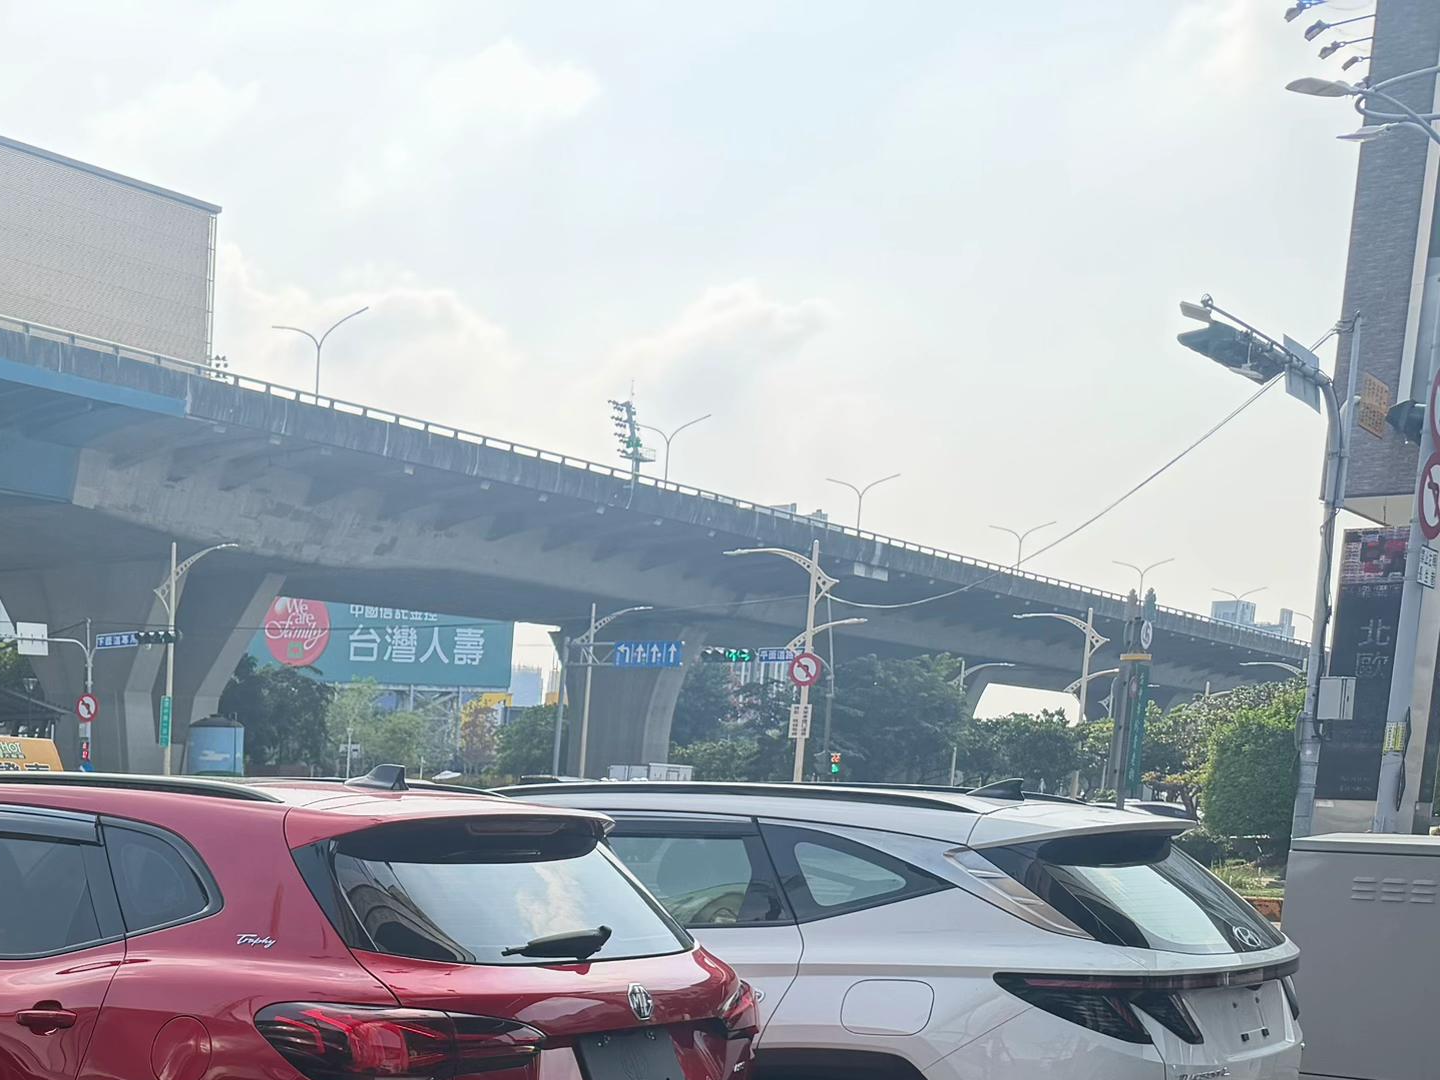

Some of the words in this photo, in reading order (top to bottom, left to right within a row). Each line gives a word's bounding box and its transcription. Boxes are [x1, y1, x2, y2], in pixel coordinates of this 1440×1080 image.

[348, 624, 485, 666] 台灣人壽
[0, 741, 23, 754] HOT
[236, 933, 277, 949] Trophy
